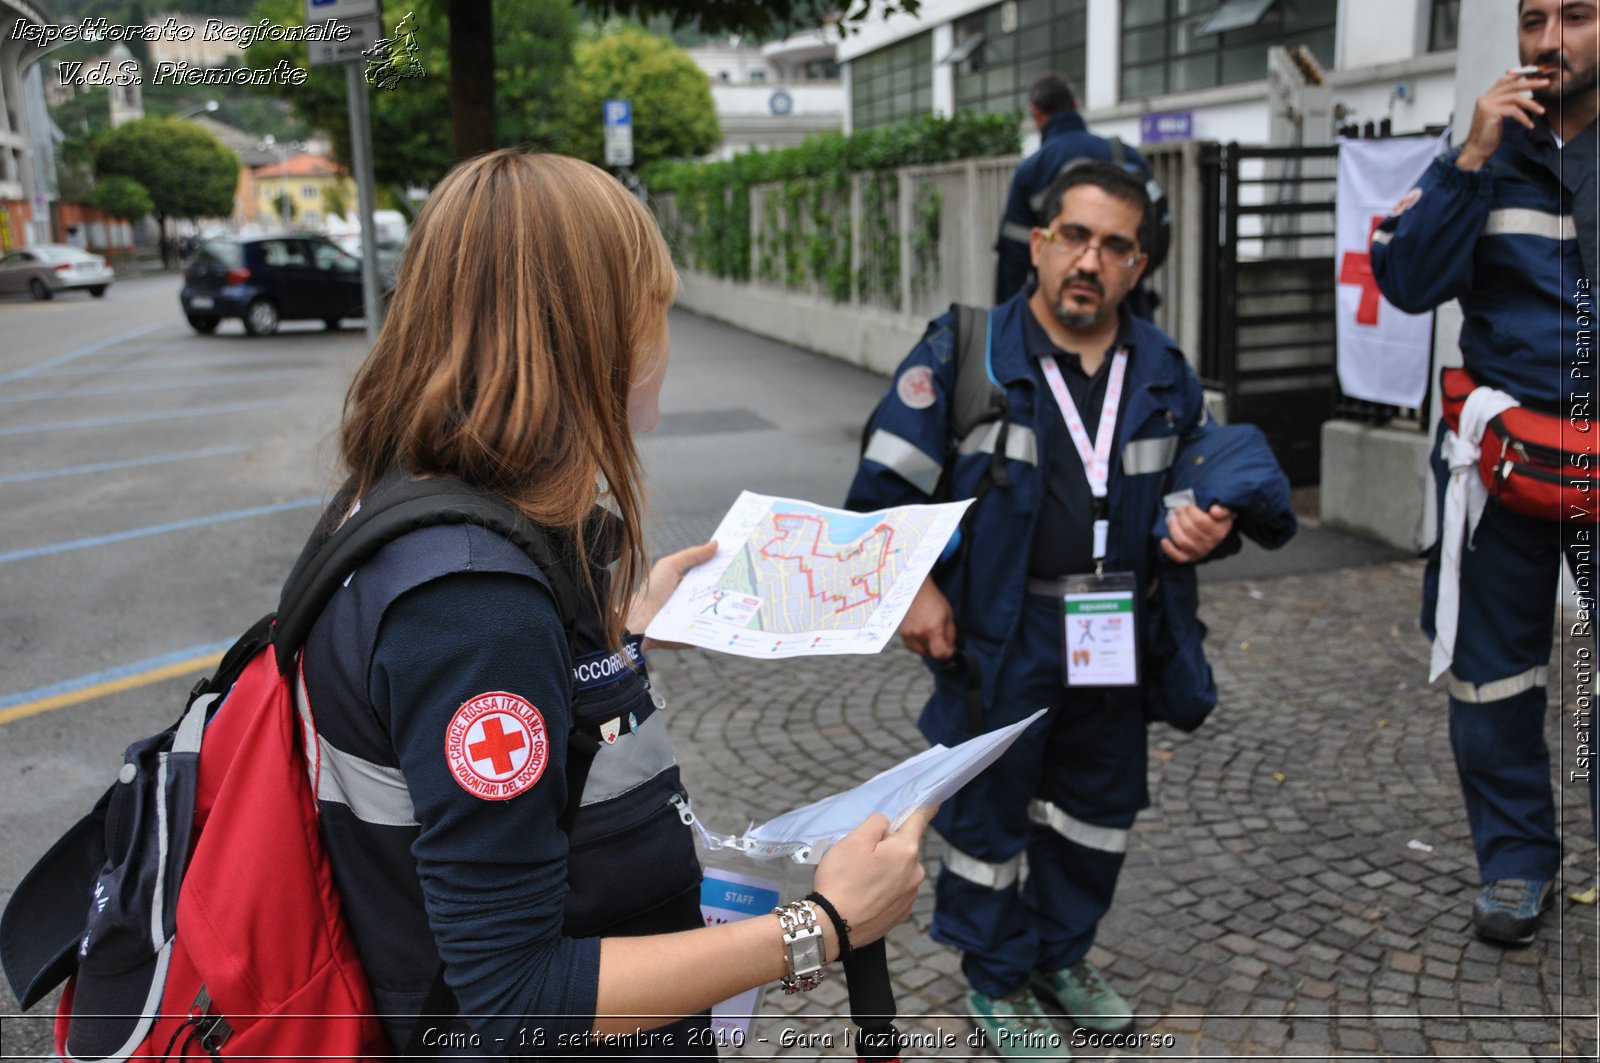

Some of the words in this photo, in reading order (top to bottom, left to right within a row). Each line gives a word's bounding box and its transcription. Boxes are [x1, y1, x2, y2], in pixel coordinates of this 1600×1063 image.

[606, 101, 627, 126] P
[460, 698, 499, 723] ROSSA
[502, 780, 521, 795] DEL
[518, 740, 545, 786] SOCCORSO
[724, 891, 755, 906] STAFF
